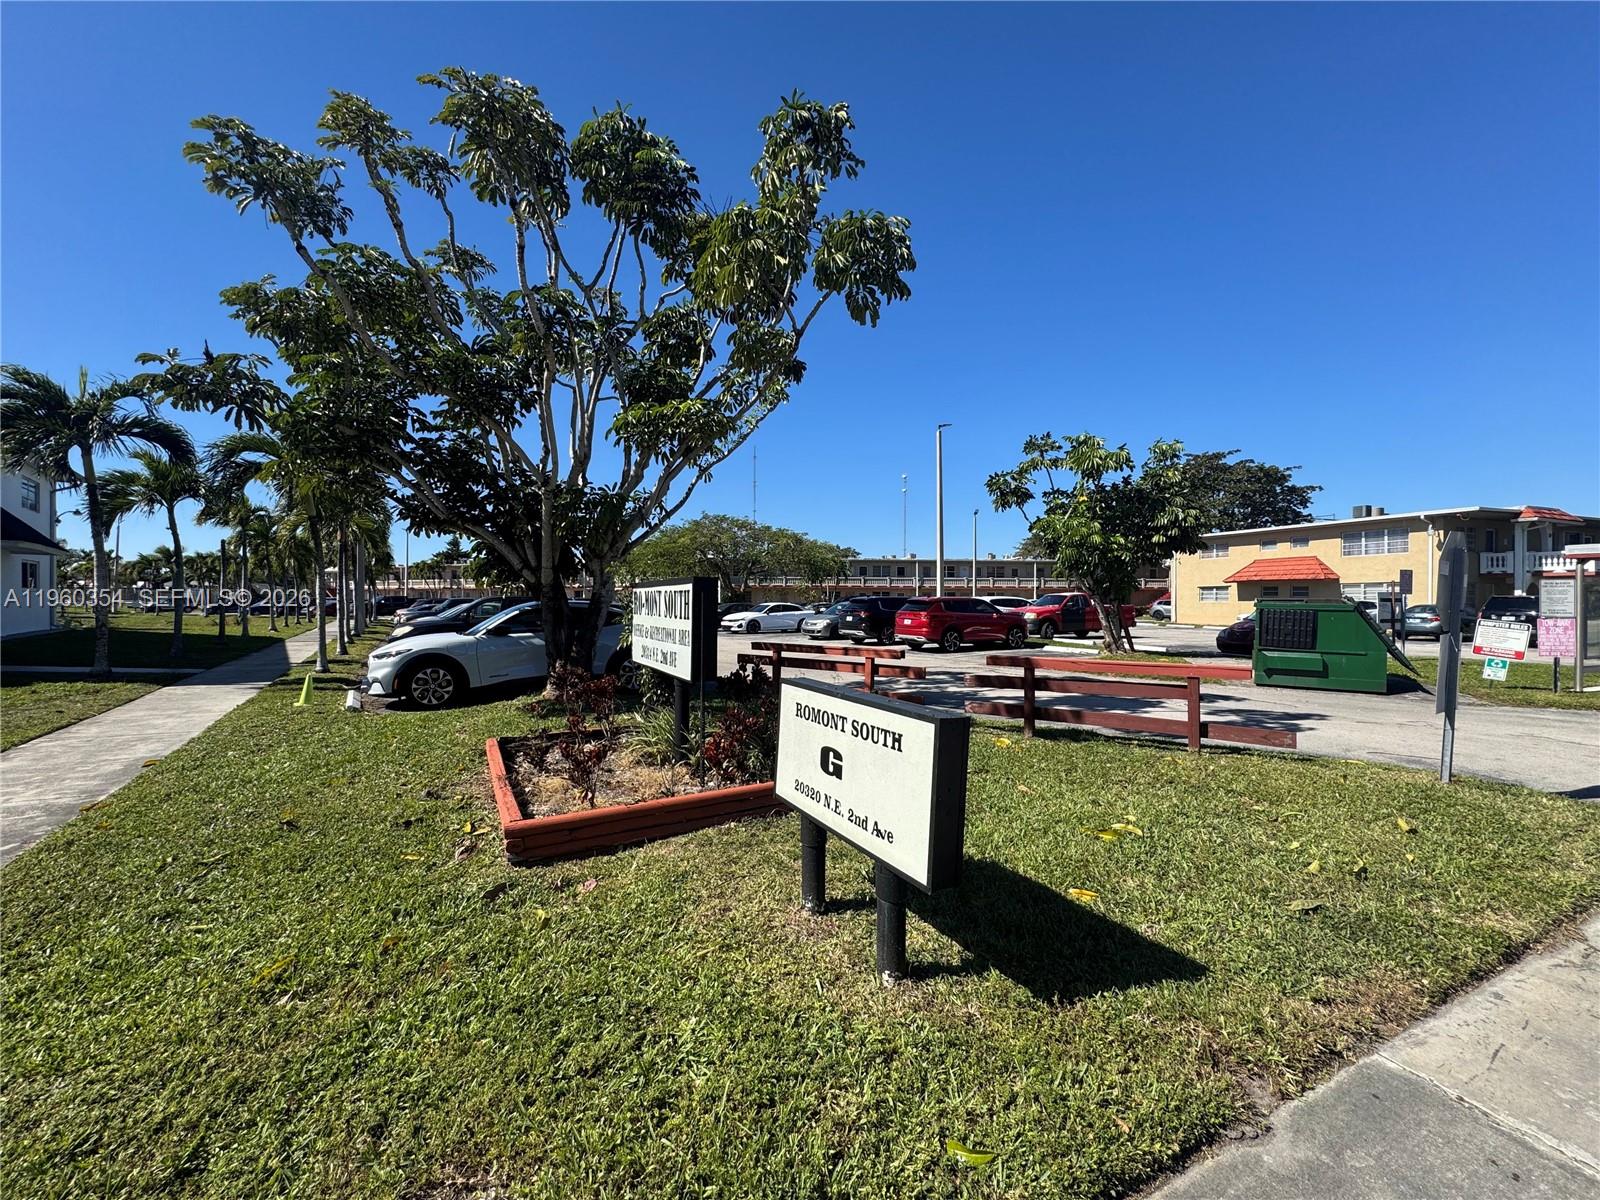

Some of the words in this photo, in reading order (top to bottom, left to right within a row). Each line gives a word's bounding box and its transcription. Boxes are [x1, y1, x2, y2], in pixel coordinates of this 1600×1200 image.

[664, 590, 690, 620] SOUTH
[795, 702, 847, 733] ROMONT
[851, 719, 904, 753] SOUTH
[819, 745, 844, 780] G
[794, 778, 821, 804] 20320
[823, 793, 845, 818] N.E.
[847, 808, 868, 833] 2nd
[871, 821, 894, 844] Ave
